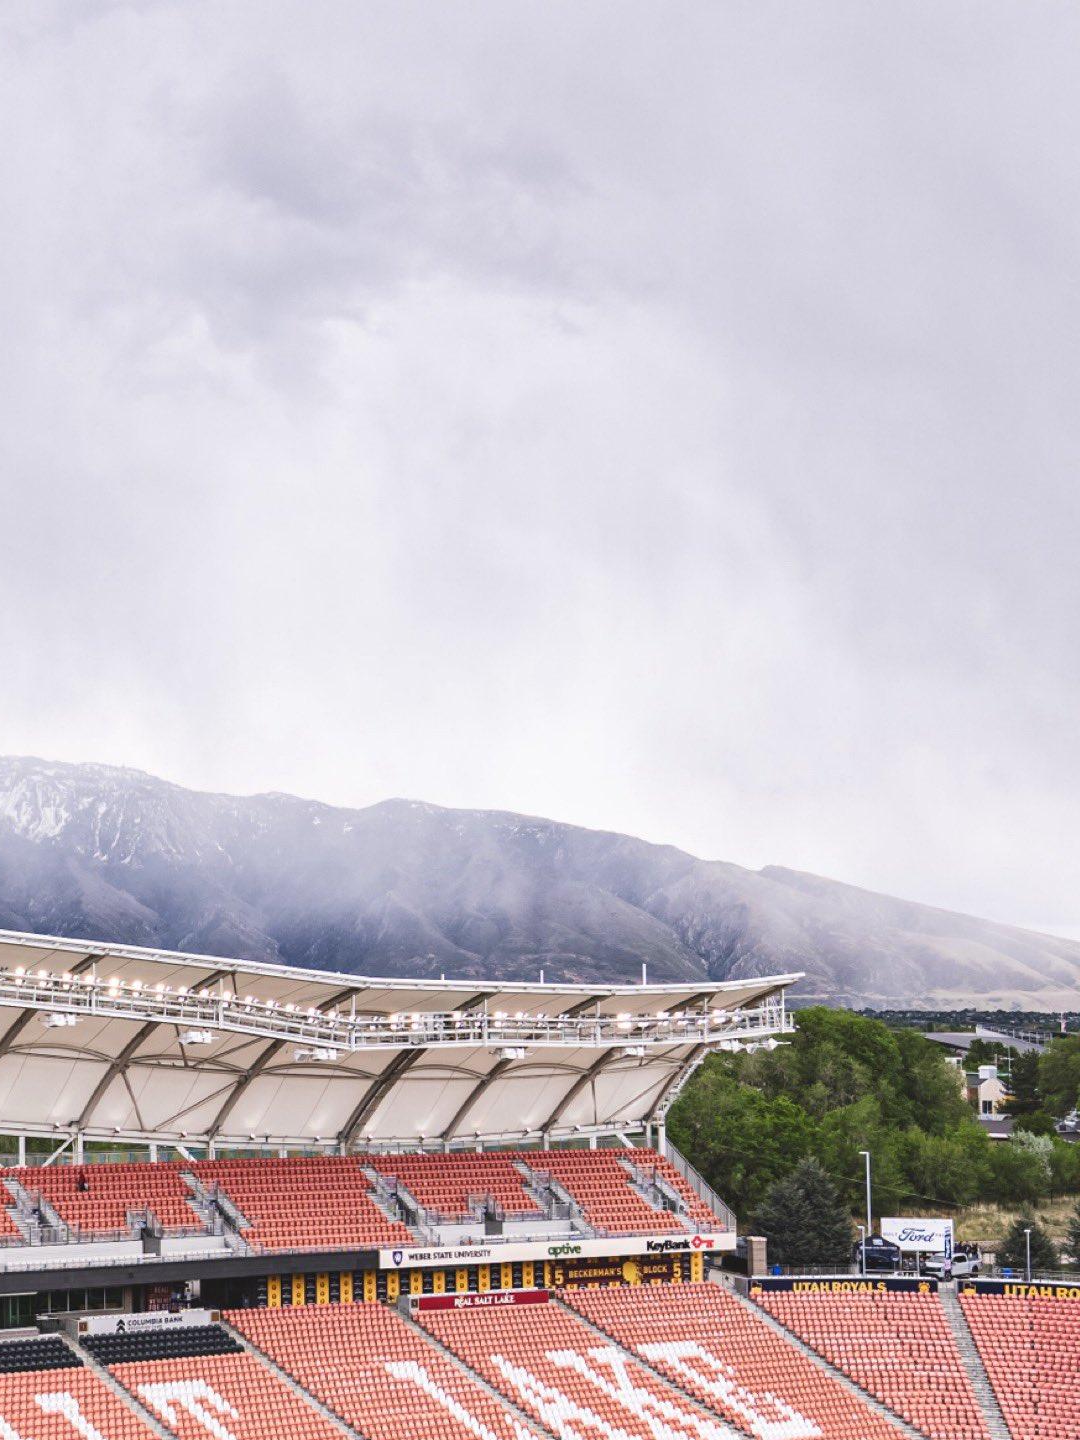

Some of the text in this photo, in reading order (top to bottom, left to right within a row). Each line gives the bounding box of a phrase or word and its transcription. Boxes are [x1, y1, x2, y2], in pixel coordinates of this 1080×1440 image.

[898, 1227, 935, 1242] Ford
[548, 1242, 581, 1257] aptive
[647, 1239, 691, 1252] KeyBank
[408, 1250, 491, 1261] WEBER STATE UNIVERSITY
[555, 1262, 681, 1285] 5 BECKERMAN'S BLOCK 5
[793, 1282, 887, 1293] UTAH ROYALS
[1004, 1285, 1052, 1297] UTAH
[454, 1293, 516, 1308] REAL SALT LAKE
[128, 1316, 183, 1326] COLUMBIA BANK
